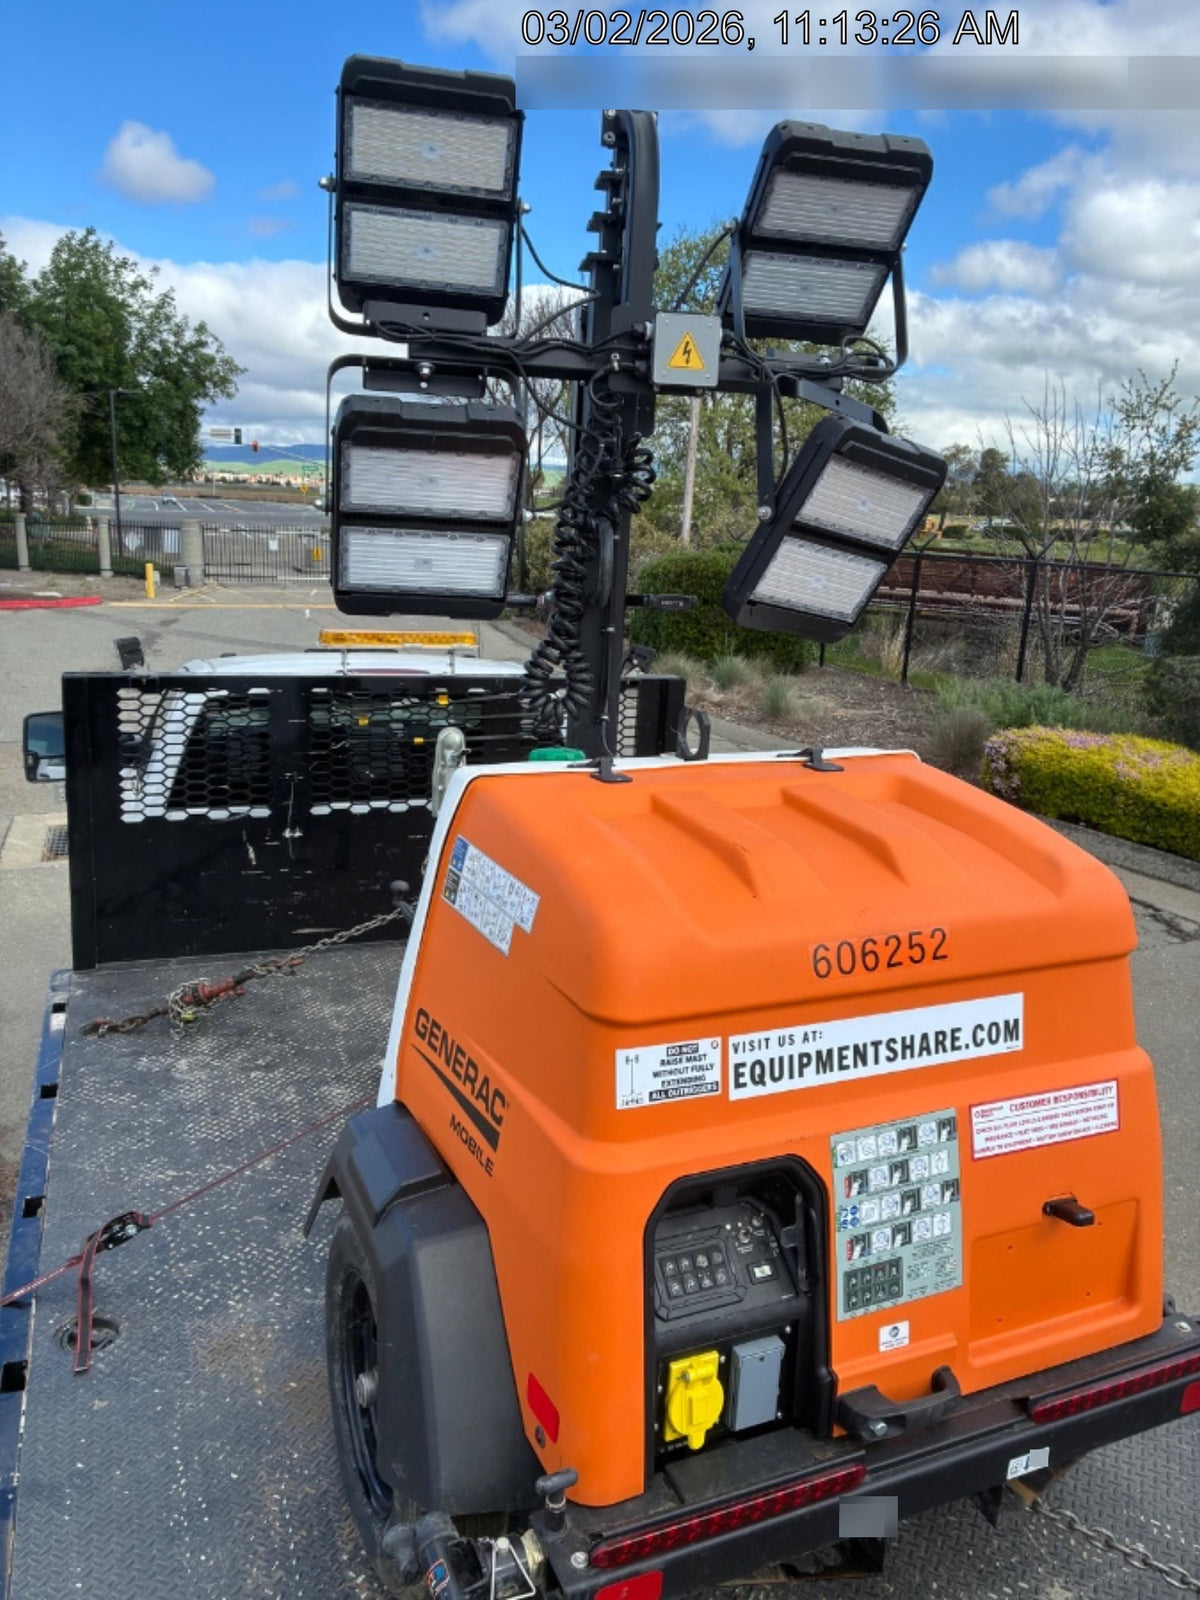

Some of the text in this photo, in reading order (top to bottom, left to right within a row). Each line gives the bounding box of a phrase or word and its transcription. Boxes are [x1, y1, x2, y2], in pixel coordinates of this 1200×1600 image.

[812, 927, 948, 979] 606252
[668, 1044, 698, 1055] DO NOT
[732, 1030, 823, 1054] VISIT US AT:
[733, 1018, 1020, 1089] EQUIPMENTSHARE.COM
[414, 1007, 506, 1126] GENERAC
[652, 1063, 715, 1078] WITHOUT FULLY
[660, 1054, 707, 1066] RAISE MAST
[1009, 1097, 1052, 1112] CUSTOMER
[449, 1113, 494, 1178] MOBILE
